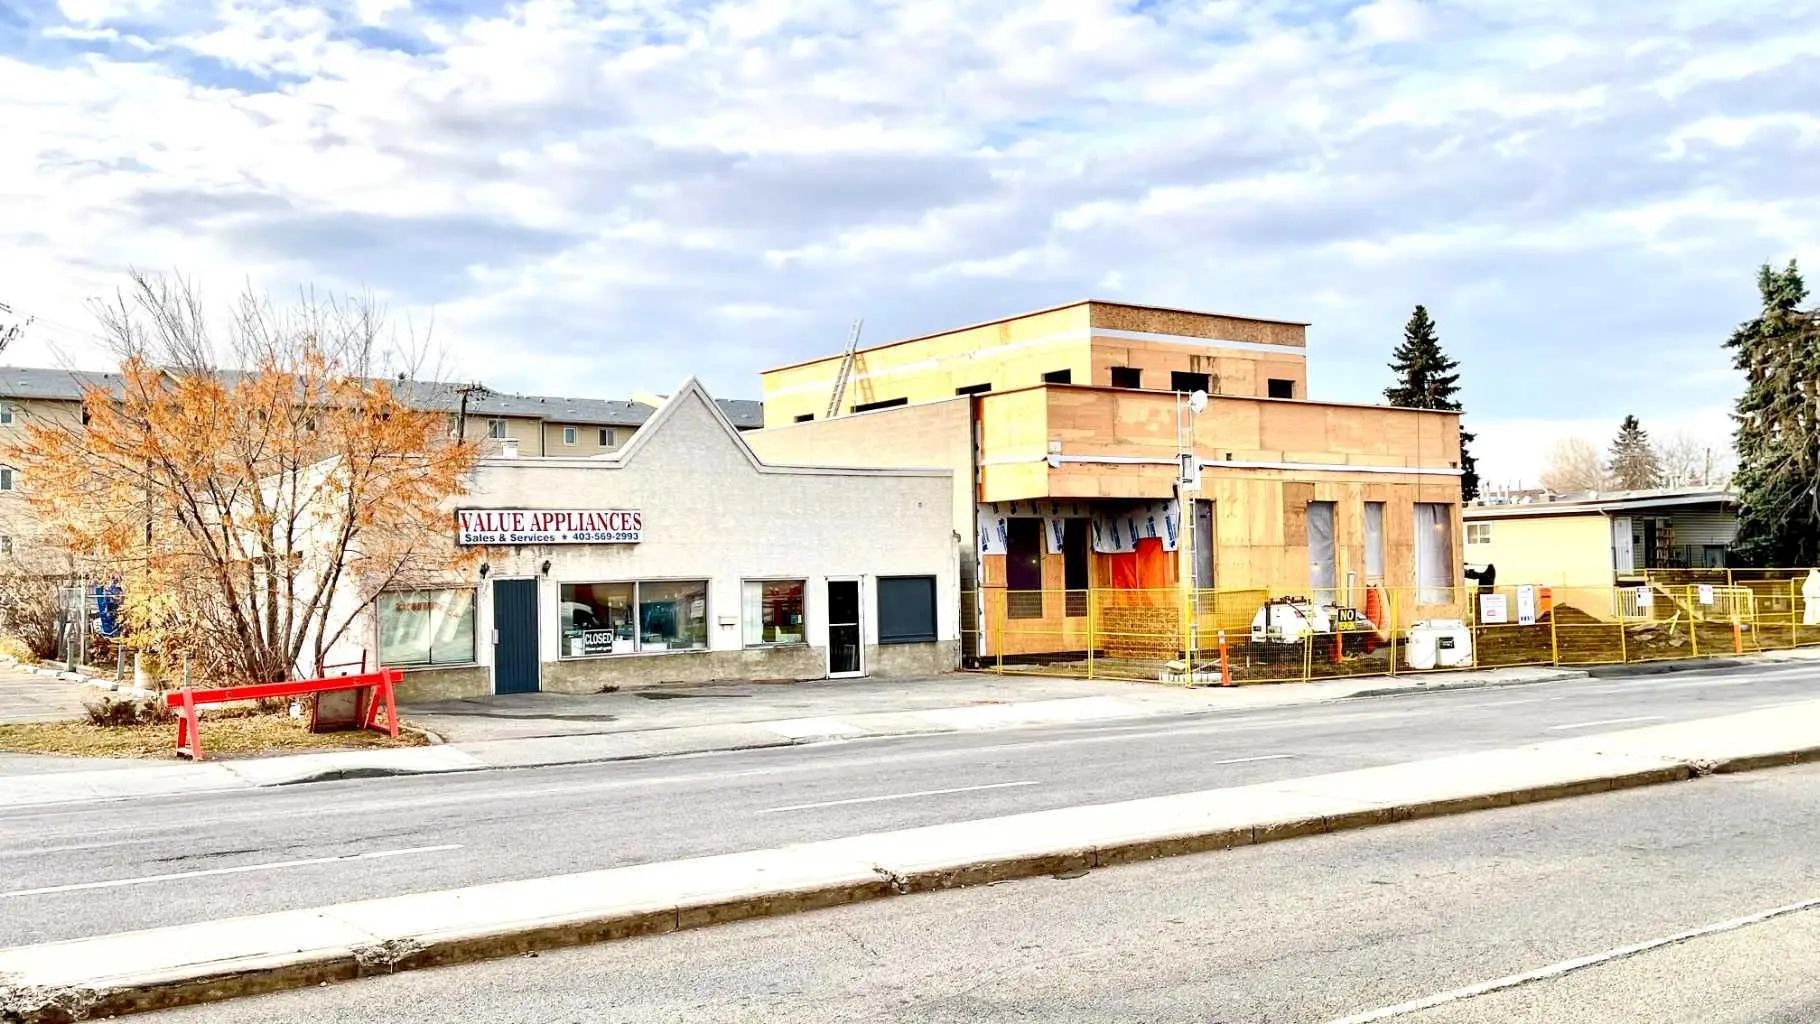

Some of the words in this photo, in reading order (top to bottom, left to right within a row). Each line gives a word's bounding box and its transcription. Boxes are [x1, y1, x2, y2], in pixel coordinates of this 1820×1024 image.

[460, 512, 524, 532] VALUE
[530, 512, 642, 532] APPLIANCES
[465, 533, 495, 542] Sales
[499, 533, 507, 542] &
[510, 532, 556, 542] Services
[1340, 609, 1355, 621] NO
[585, 633, 612, 645] CLOSED
